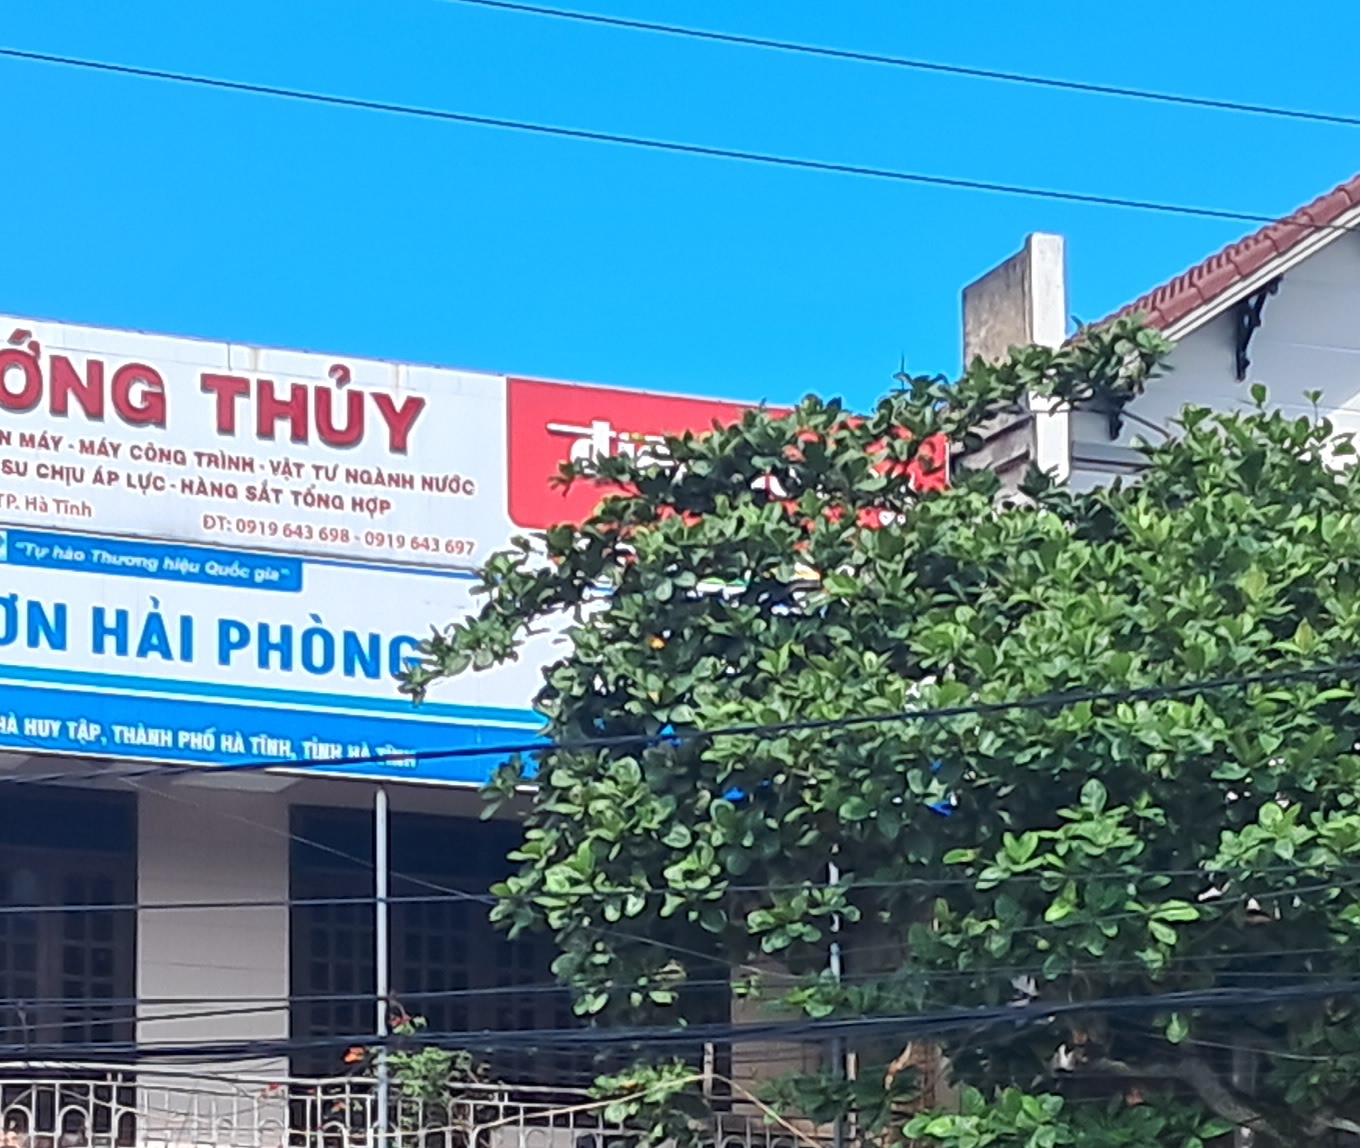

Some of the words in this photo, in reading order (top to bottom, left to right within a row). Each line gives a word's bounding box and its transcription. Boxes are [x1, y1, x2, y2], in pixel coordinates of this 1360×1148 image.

[200, 364, 427, 455] THỦY
[19, 430, 64, 451] MÁY
[79, 437, 121, 459] MÁY
[129, 443, 187, 466] CÔNG
[194, 450, 255, 473] TRÌNH
[269, 457, 305, 482] VẬT
[311, 463, 340, 482] TƯ
[346, 467, 415, 490] NGÀNH
[1, 459, 29, 477] SU
[37, 464, 85, 488] CHỊU
[92, 465, 120, 487] ÁP
[127, 472, 166, 492] LỰC
[181, 475, 238, 499] HÀNG
[352, 497, 392, 519] HỢP
[25, 495, 49, 513] Hà
[203, 514, 232, 532] ĐT:
[236, 518, 278, 537] 0919
[283, 523, 314, 540] 643
[319, 526, 350, 543] 698
[365, 530, 406, 548] 0919
[410, 535, 441, 552] 643
[445, 539, 476, 556] 697
[52, 545, 86, 562] hào
[91, 549, 158, 572] Thương
[163, 556, 200, 576] hiệu
[205, 559, 251, 580] Quốc
[92, 595, 193, 664] HẢI
[218, 612, 426, 682] PHÒNG
[24, 718, 62, 739] HUY
[112, 721, 173, 748] THÀNH
[178, 727, 216, 752] PHỐ
[221, 730, 246, 754] HÀ
